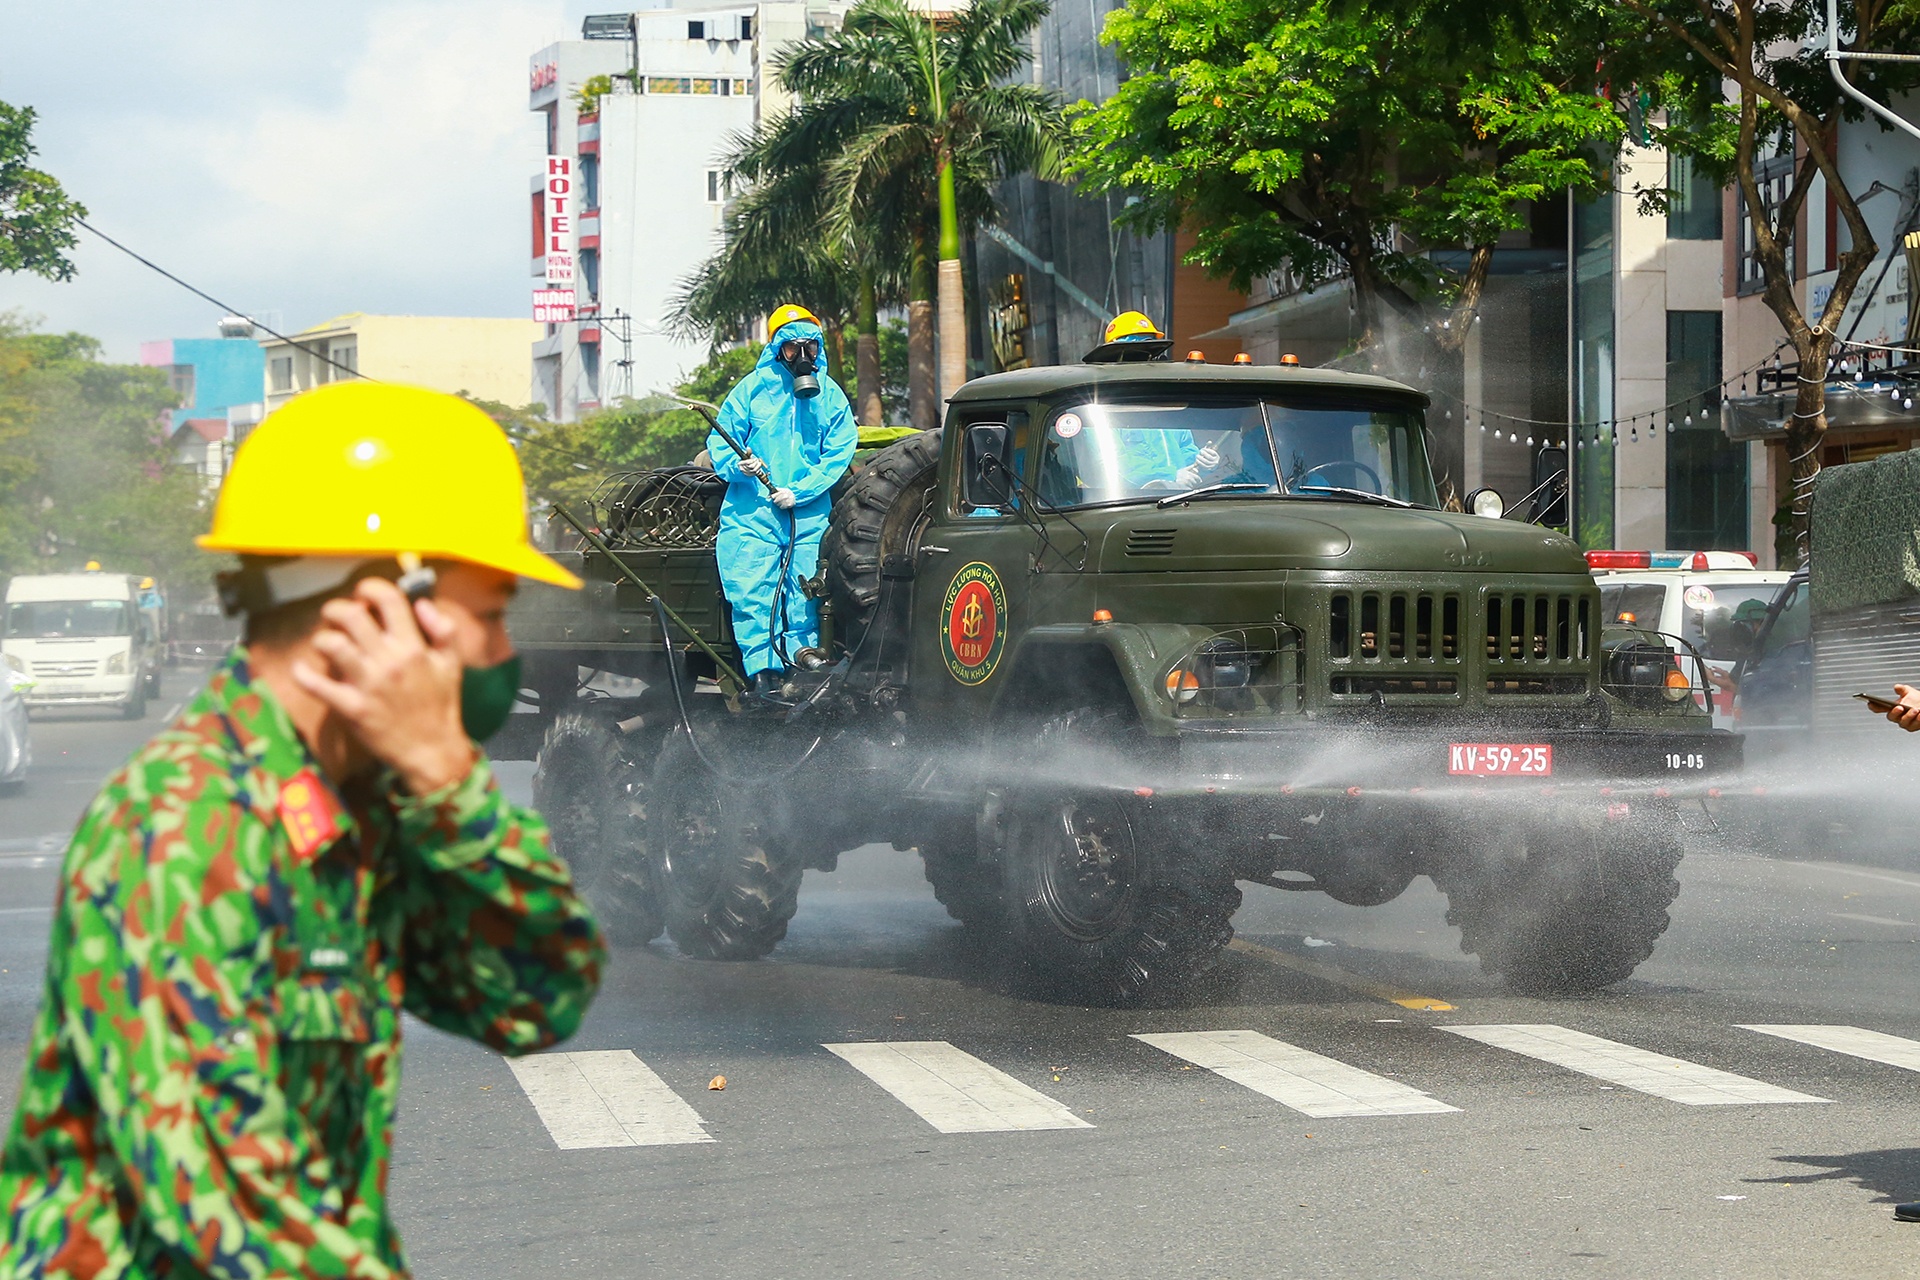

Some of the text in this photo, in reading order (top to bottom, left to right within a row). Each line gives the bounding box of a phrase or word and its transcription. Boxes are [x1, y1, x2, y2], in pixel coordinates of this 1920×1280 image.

[549, 158, 570, 252] HOTEL
[959, 643, 983, 658] CBRN
[951, 659, 991, 680] QUÂN KHU 5
[1452, 746, 1547, 772] KV-59-25
[1665, 753, 1704, 769] 10-05
